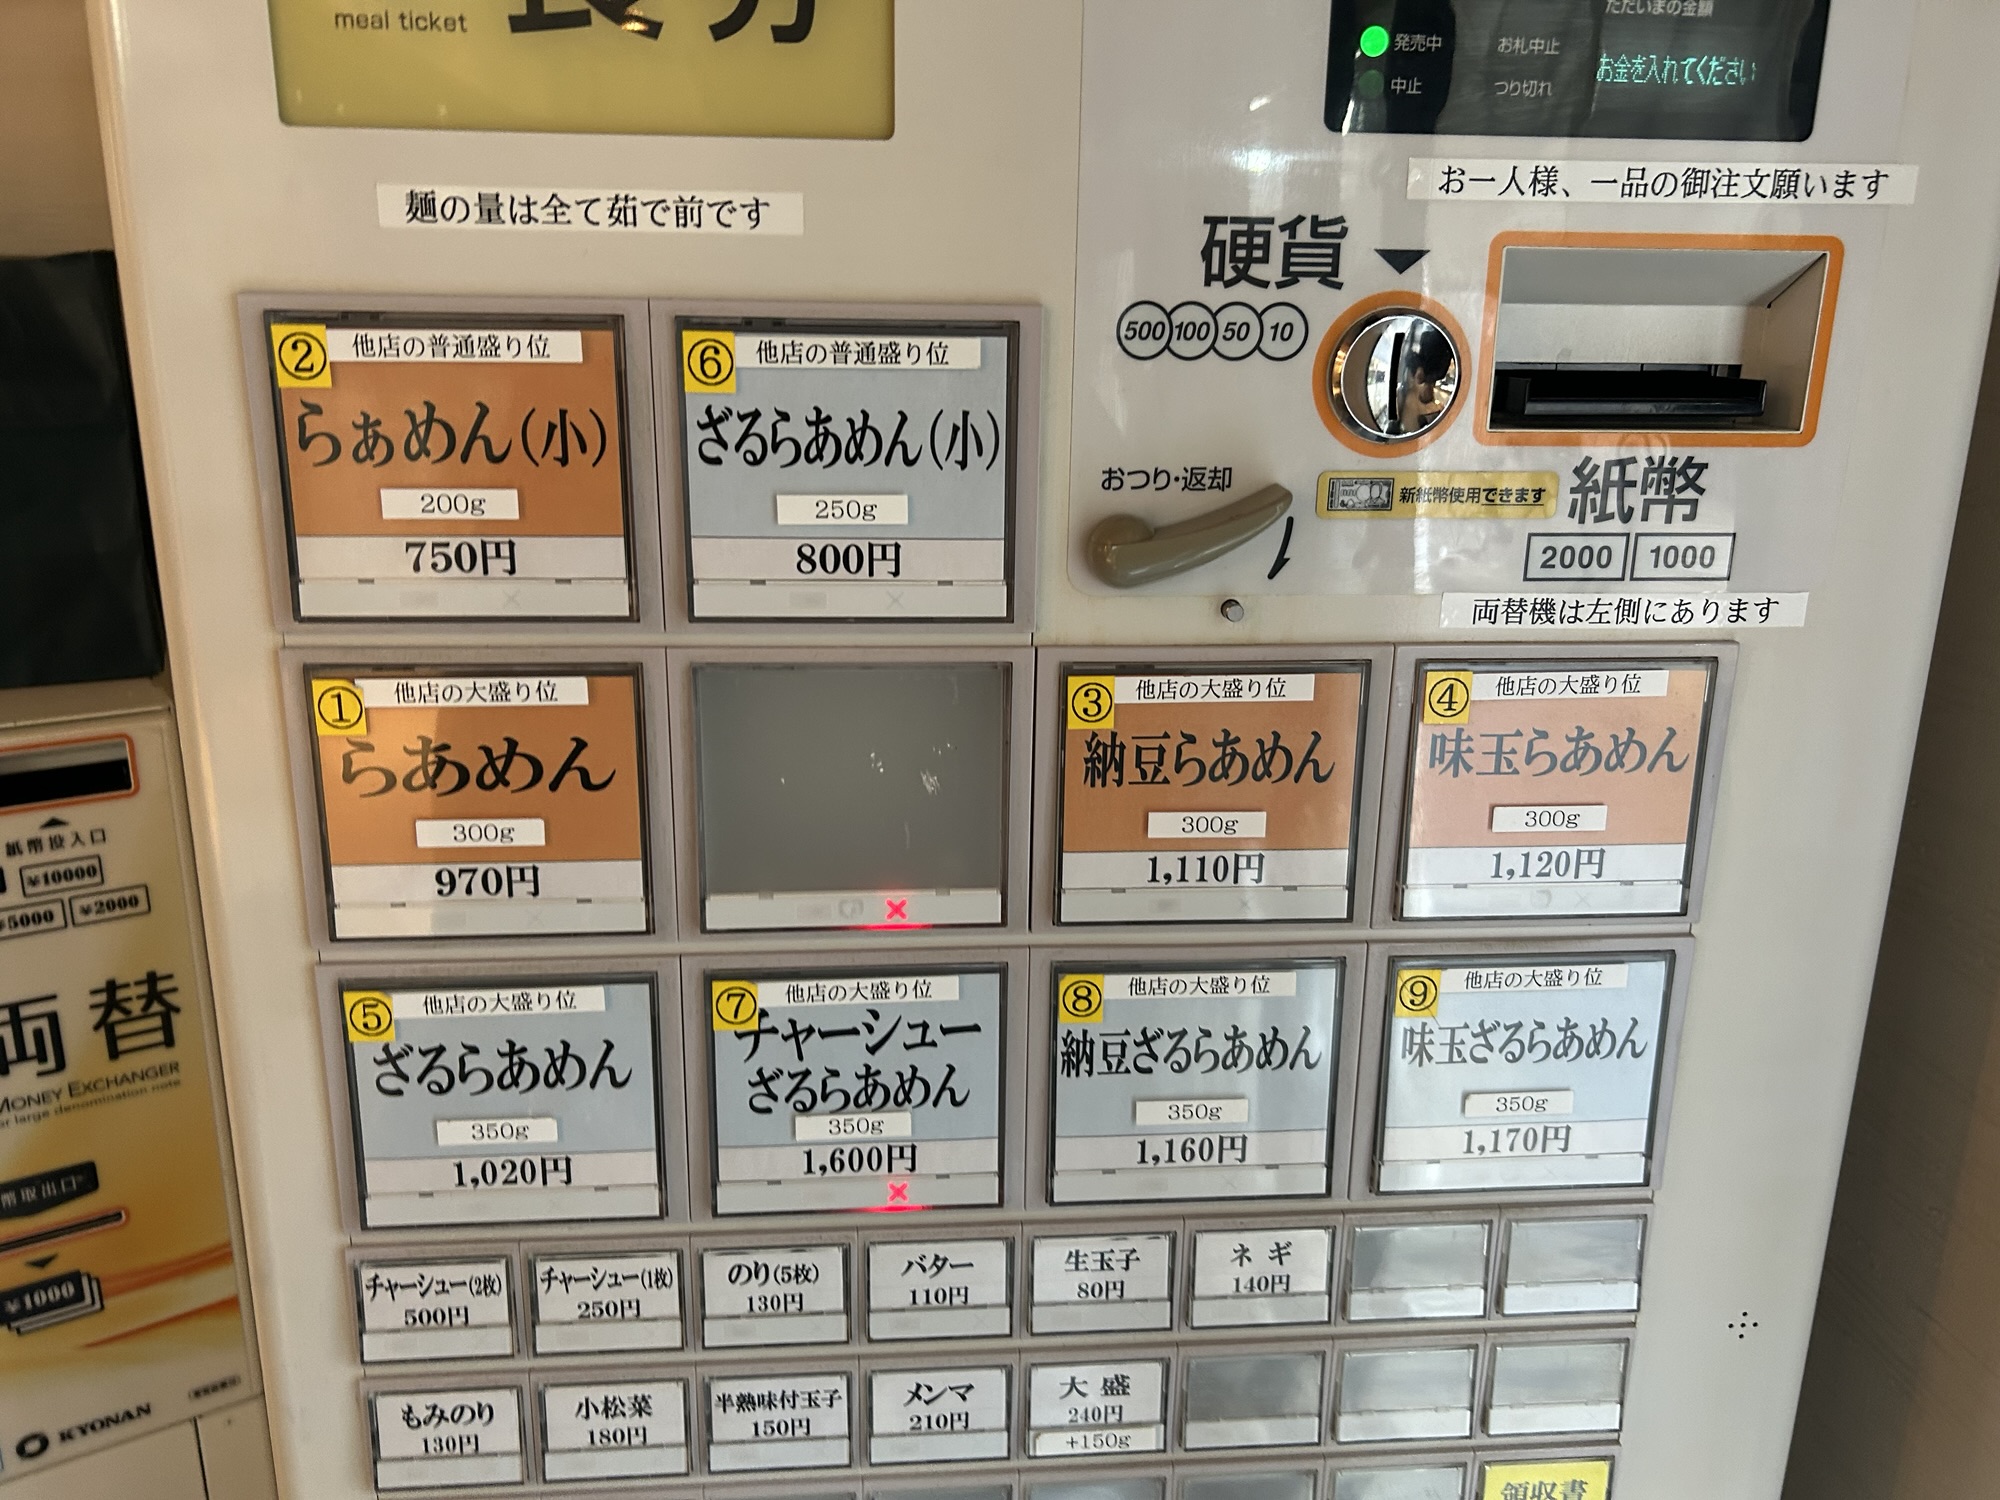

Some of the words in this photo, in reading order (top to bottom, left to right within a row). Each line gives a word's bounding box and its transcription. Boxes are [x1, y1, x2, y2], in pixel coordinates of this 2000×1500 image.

[334, 9, 389, 31] meal
[397, 9, 468, 33] ticket
[1394, 33, 1442, 53] 発売中
[1497, 35, 1559, 56] お札中止
[1597, 52, 1757, 86] お金を入れてください
[1391, 77, 1422, 96] 中止
[1495, 79, 1552, 98] つり切れ
[1438, 164, 1889, 202] お一人様、一品の御注文願います
[405, 189, 771, 231] 麺の量は全て茹で前です
[1200, 214, 1348, 291] 硬貨
[1124, 318, 1166, 341] 500
[1174, 318, 1210, 341] 100
[1222, 318, 1250, 341] 50
[1269, 318, 1294, 341] 10
[352, 331, 552, 362] 他店の普通盛り位
[755, 340, 950, 368] 他店の普通盛り位
[1100, 466, 1232, 493] おつり・返却
[1567, 455, 1708, 525] 紙幣
[420, 491, 487, 517] 200g
[1399, 484, 1547, 507] 新紙幣使用できます
[815, 498, 878, 524] 250g
[405, 539, 517, 576] 750円
[795, 542, 902, 577] 800円
[1540, 545, 1613, 571] 2000
[1648, 545, 1716, 571] 1000
[1472, 597, 1780, 628] 両替機は左側にあります
[393, 680, 559, 704] 他店の大盛り位
[1135, 678, 1287, 701] 他店の大盛り位
[1494, 674, 1642, 698] 他店の大盛り位
[1083, 728, 1335, 789] 納豆らあめん
[1429, 725, 1690, 779] 味玉らあめん
[340, 735, 617, 799] らあめん
[1181, 814, 1239, 835] 300g
[1524, 808, 1581, 830] 300g
[6, 828, 106, 857] 紙幣投入口
[452, 823, 515, 845] 300g
[27, 864, 98, 888] ¥10000
[1146, 852, 1266, 886] 1,110円
[1490, 847, 1606, 880] 1,120円
[434, 864, 541, 899] 970円
[80, 894, 139, 916] ¥2000
[785, 979, 934, 1003] 他店の大盛り位
[1128, 974, 1271, 997] 他店の大盛り位
[1463, 968, 1603, 990] 他店の大盛り位
[421, 989, 578, 1015] 他店の大盛り位
[733, 1009, 983, 1063] チャーシュー
[1401, 1016, 1648, 1068] 味玉ざるらあめん
[1060, 1024, 1321, 1079] 納豆ざるらあめん
[373, 1037, 634, 1097] ざるらあめん
[746, 1062, 971, 1115] ざるらあめん
[1167, 1102, 1223, 1122] 350g
[1495, 1095, 1548, 1114] 350g
[471, 1120, 530, 1141] 350g
[827, 1115, 885, 1135] 350g
[1136, 1134, 1248, 1165] 1,160円
[1462, 1125, 1572, 1155] 1,170円
[801, 1143, 919, 1175] 1,600円
[452, 1156, 574, 1189] 1,020円
[900, 1254, 974, 1278] バター
[1064, 1248, 1140, 1273] 生玉子
[909, 1286, 969, 1306] 110円
[1076, 1280, 1125, 1300] 80円
[1231, 1273, 1291, 1295] 140円
[4, 1281, 76, 1313] ¥1000
[746, 1293, 804, 1314] 130円
[404, 1306, 470, 1327] 500円
[577, 1300, 641, 1320] 250円
[903, 1382, 975, 1407] メンマ
[1059, 1374, 1131, 1399] 大盛
[575, 1394, 652, 1419] 小松菜
[714, 1389, 842, 1414] 半熟味付玉子
[58, 1402, 152, 1442] KYONAN
[401, 1402, 495, 1428] もみのり
[909, 1411, 970, 1432] 210円
[1068, 1405, 1124, 1425] 240円
[587, 1426, 647, 1447] 180円
[751, 1418, 811, 1438] 150円
[422, 1434, 480, 1455] 130円
[1065, 1432, 1131, 1450] +150g
